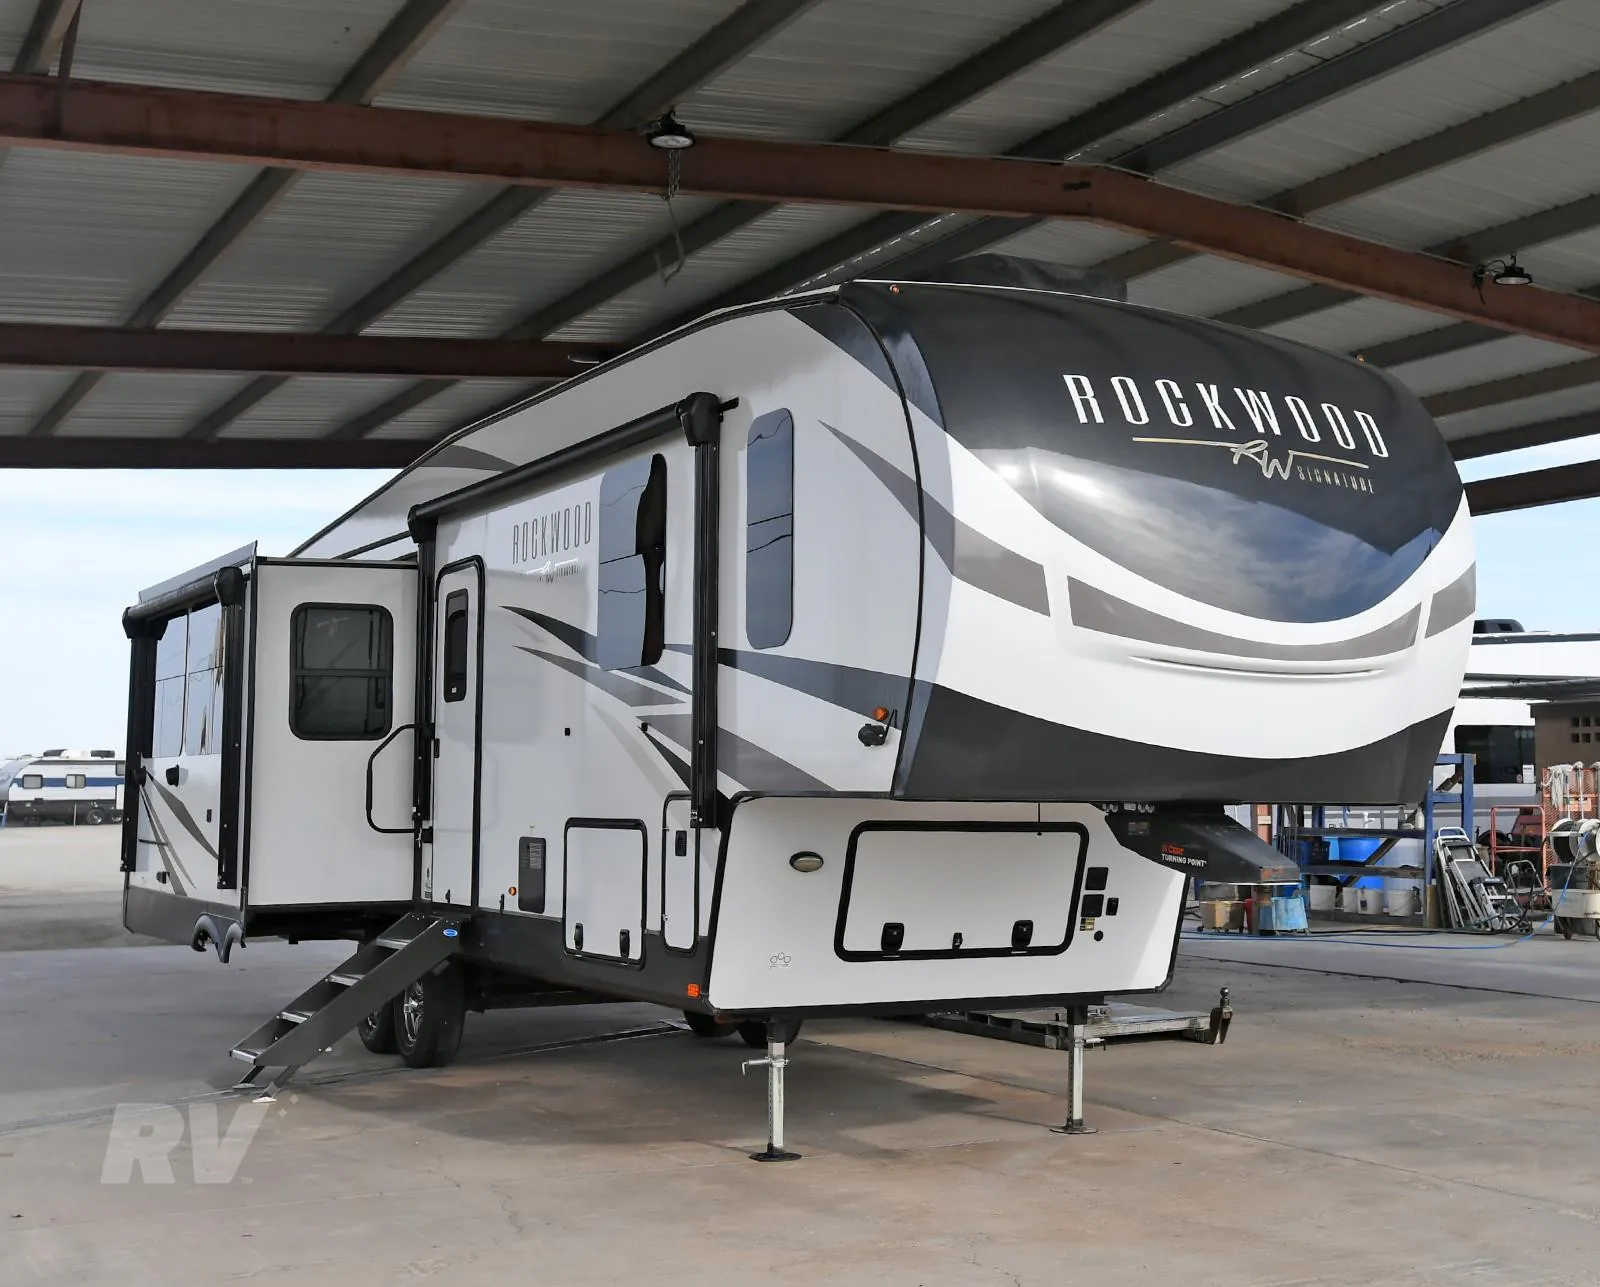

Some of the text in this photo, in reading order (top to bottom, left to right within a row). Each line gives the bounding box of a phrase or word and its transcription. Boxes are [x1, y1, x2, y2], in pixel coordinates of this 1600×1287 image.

[1063, 375, 1389, 458] ROCKWOOD
[512, 501, 591, 565] ROCKWOOD
[1161, 853, 1187, 864] TURNING
